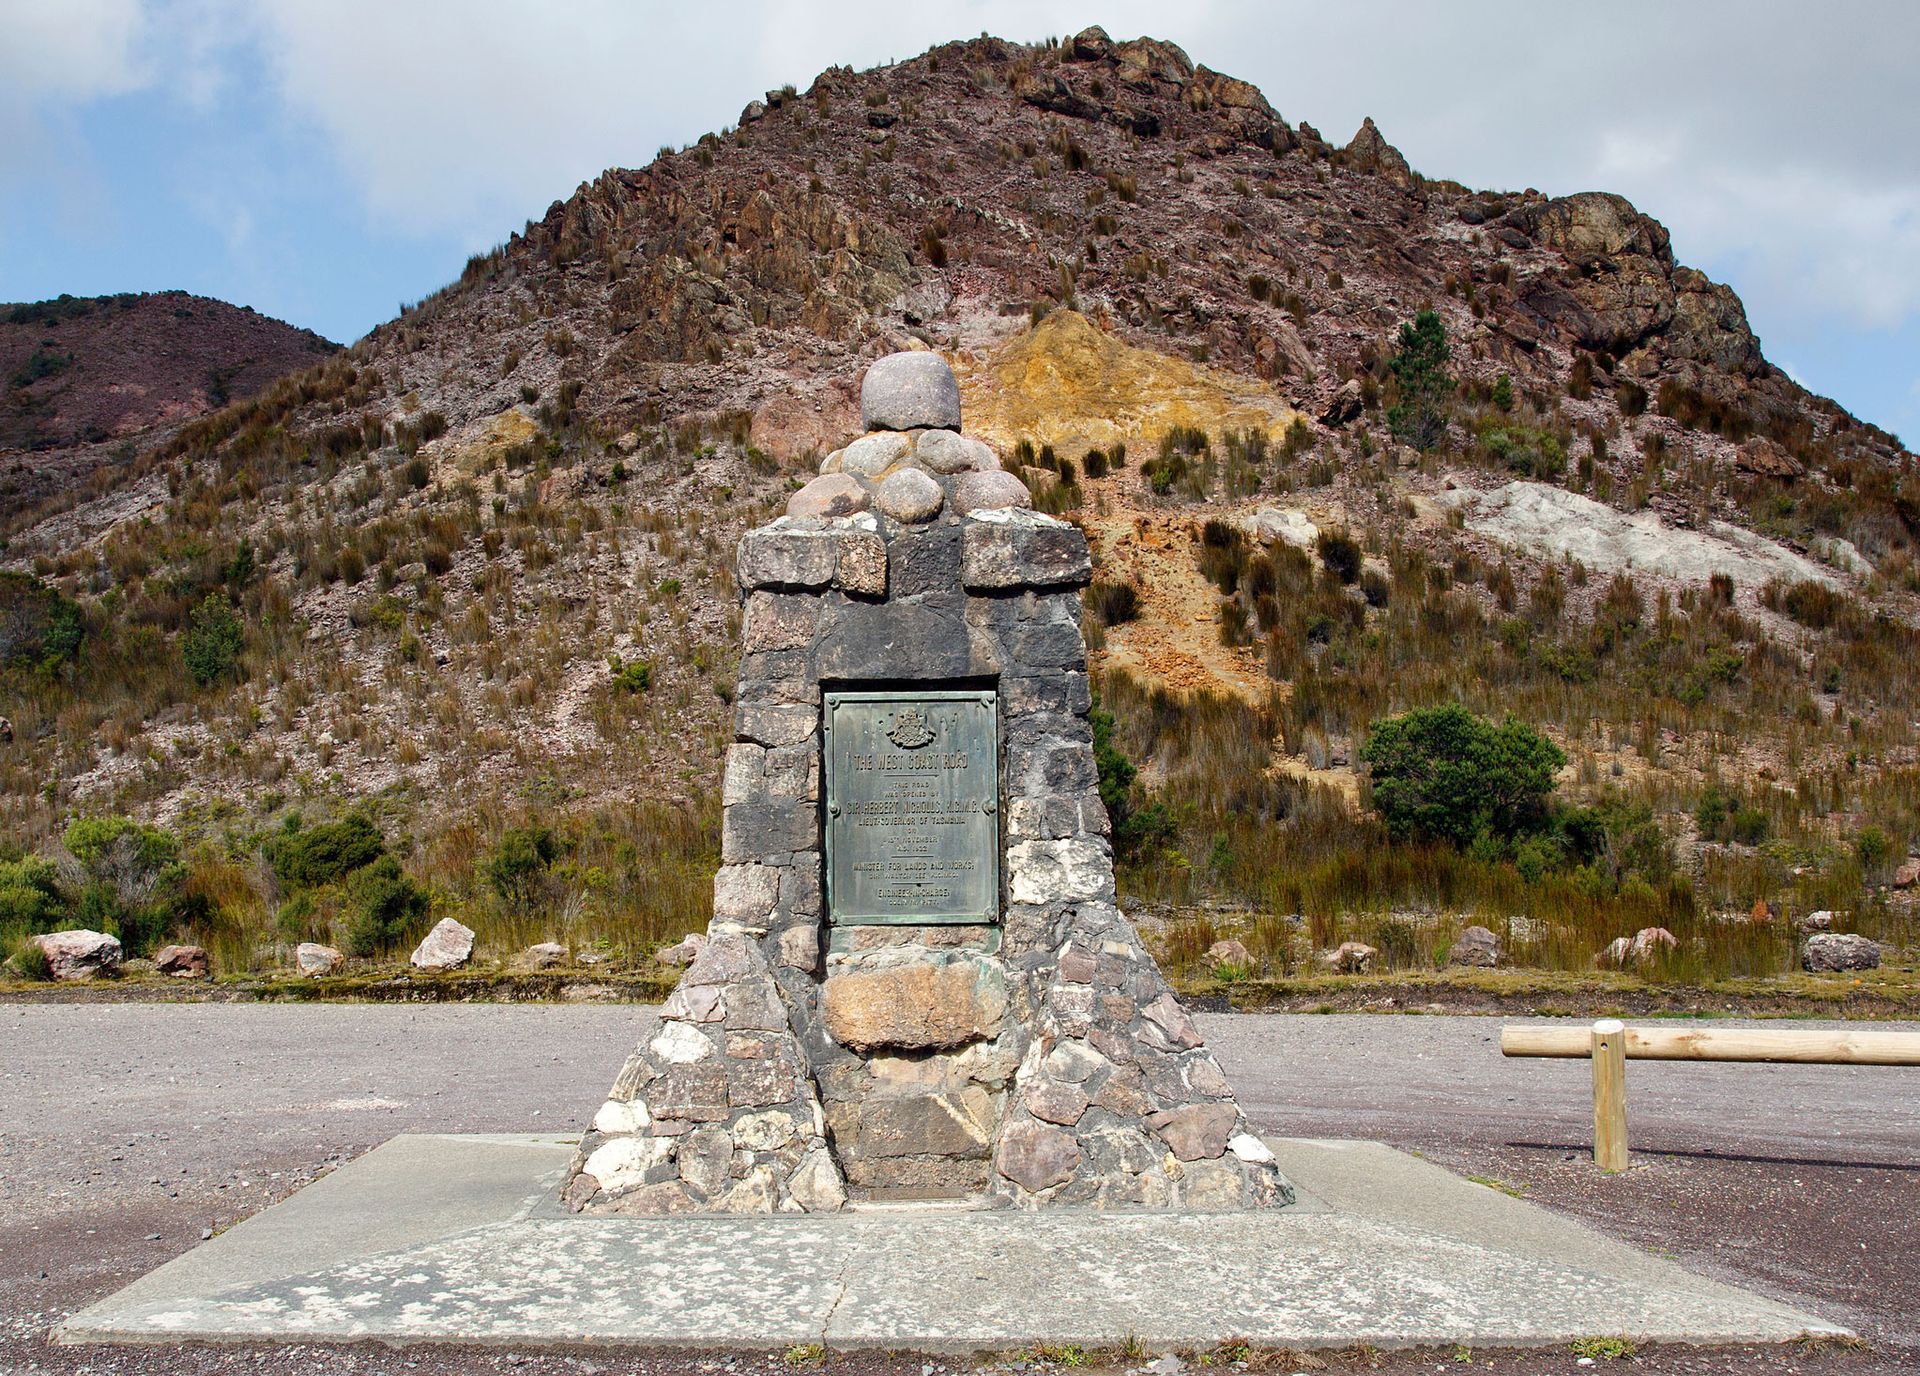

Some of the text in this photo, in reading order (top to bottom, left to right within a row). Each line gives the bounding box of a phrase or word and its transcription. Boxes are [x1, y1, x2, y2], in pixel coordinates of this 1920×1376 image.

[853, 751, 968, 770] THE WEST COAST ROAD
[888, 862, 902, 871] FOR
